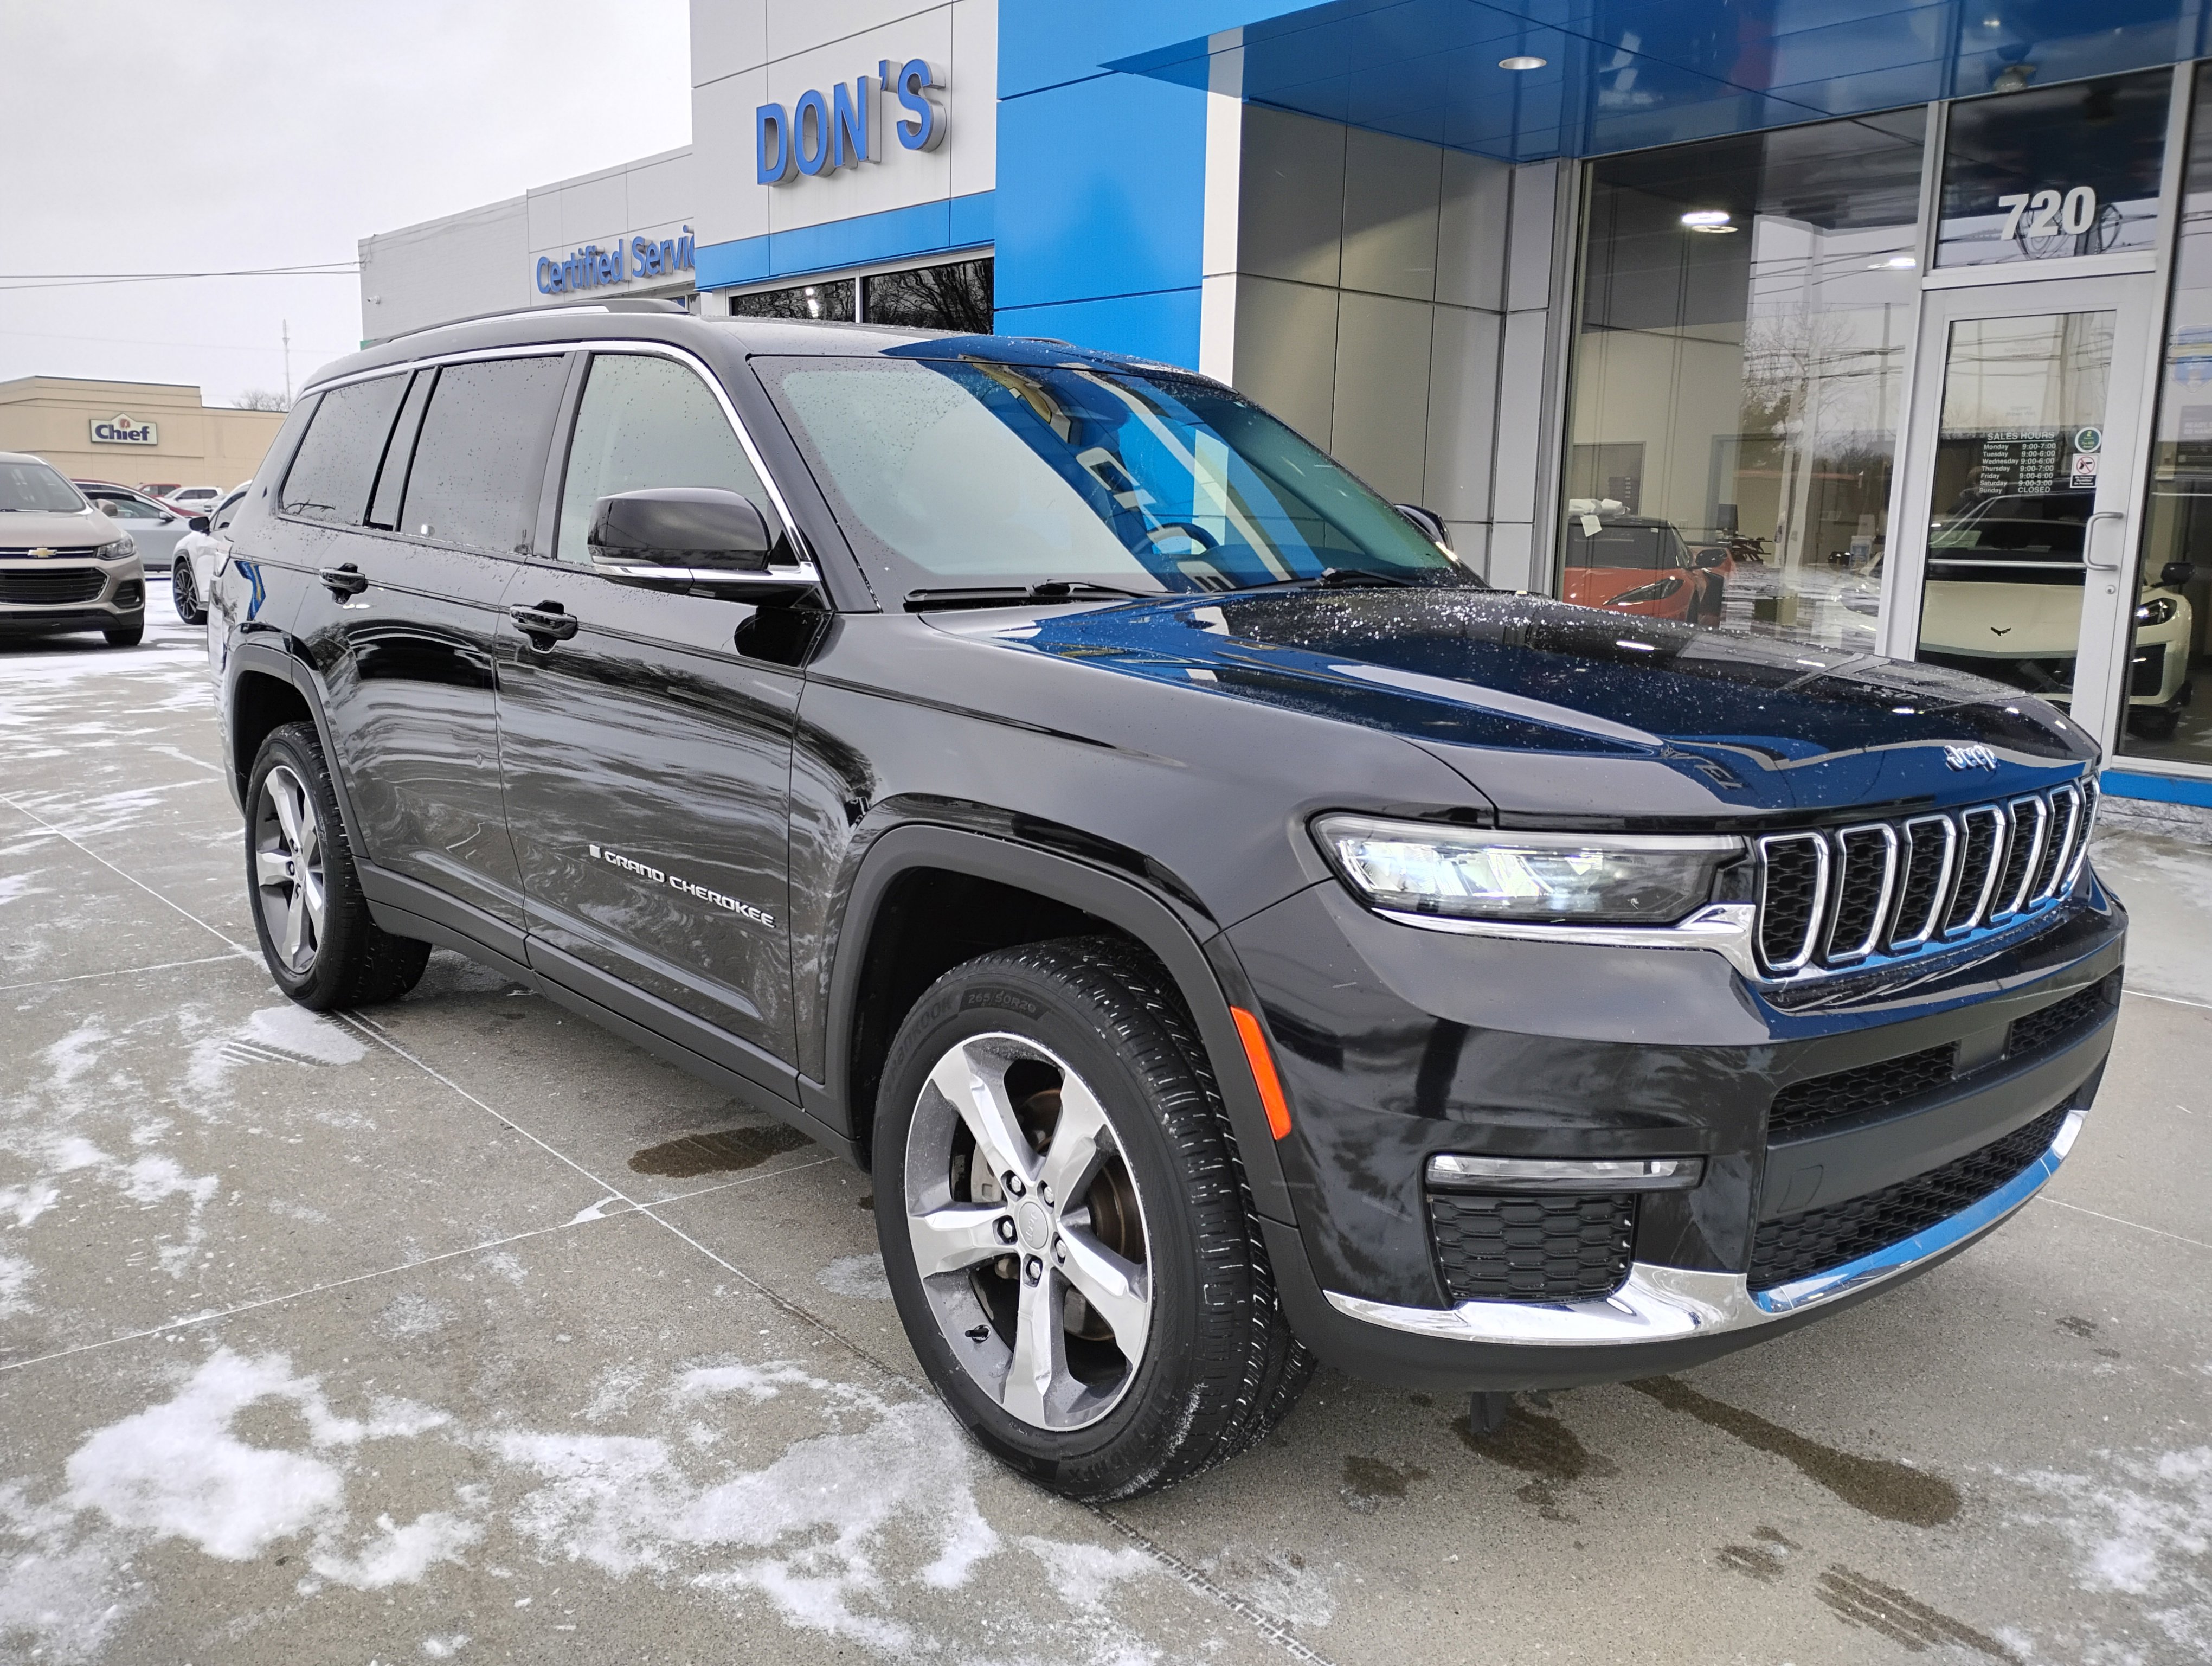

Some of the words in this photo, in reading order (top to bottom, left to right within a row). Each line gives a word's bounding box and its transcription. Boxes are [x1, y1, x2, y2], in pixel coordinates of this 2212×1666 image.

[756, 59, 939, 185] DON'S
[1998, 186, 2096, 240] 720
[537, 239, 623, 294] Certified
[95, 424, 150, 441] Chief
[1944, 745, 1997, 772] Jeep
[604, 851, 666, 883] GRAND
[670, 876, 777, 928] CHEROKEE
